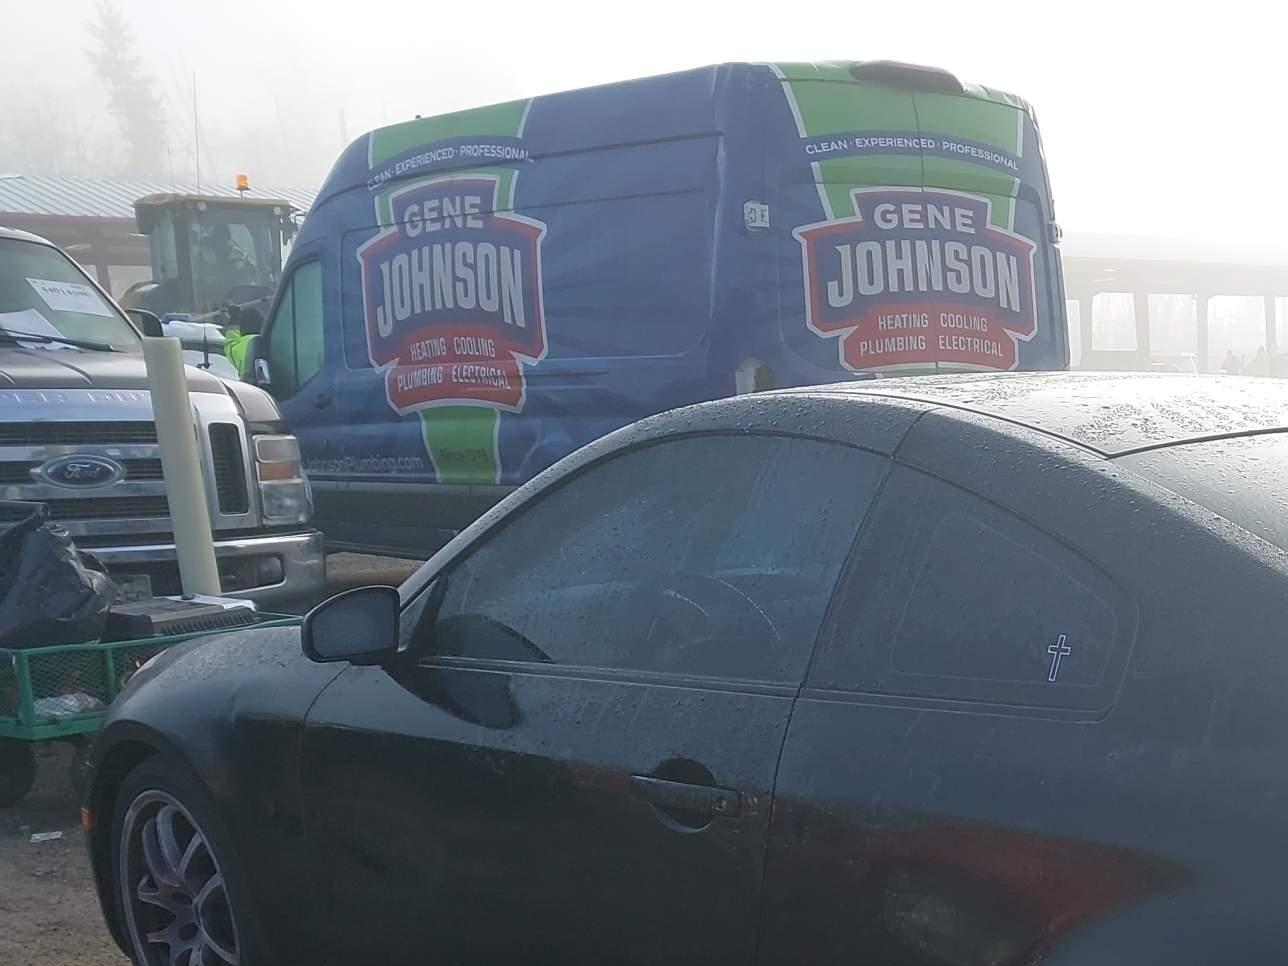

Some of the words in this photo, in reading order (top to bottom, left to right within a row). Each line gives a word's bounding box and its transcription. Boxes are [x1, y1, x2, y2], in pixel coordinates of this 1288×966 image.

[367, 171, 391, 191] CLEAN
[395, 147, 454, 175] EXPERIENCED
[459, 144, 535, 162] PROFESSIONAL
[805, 139, 848, 154] CLEAN
[855, 137, 935, 149] EXPERIENCED
[942, 141, 1019, 170] PROFESSIONAL
[403, 196, 484, 238] GENE
[873, 203, 976, 234] GENE
[376, 241, 526, 338] JOHNSON
[827, 239, 1021, 313] JOHNSON
[878, 313, 929, 331] HEATING
[940, 313, 988, 332] COOLING
[409, 338, 447, 362] HEATING
[453, 336, 496, 358] COOLING
[860, 335, 926, 357] PLUMBING
[938, 335, 1004, 357] ELECTRICAL
[397, 366, 443, 392] PLUMBING
[452, 365, 511, 390] ELECTRICAL
